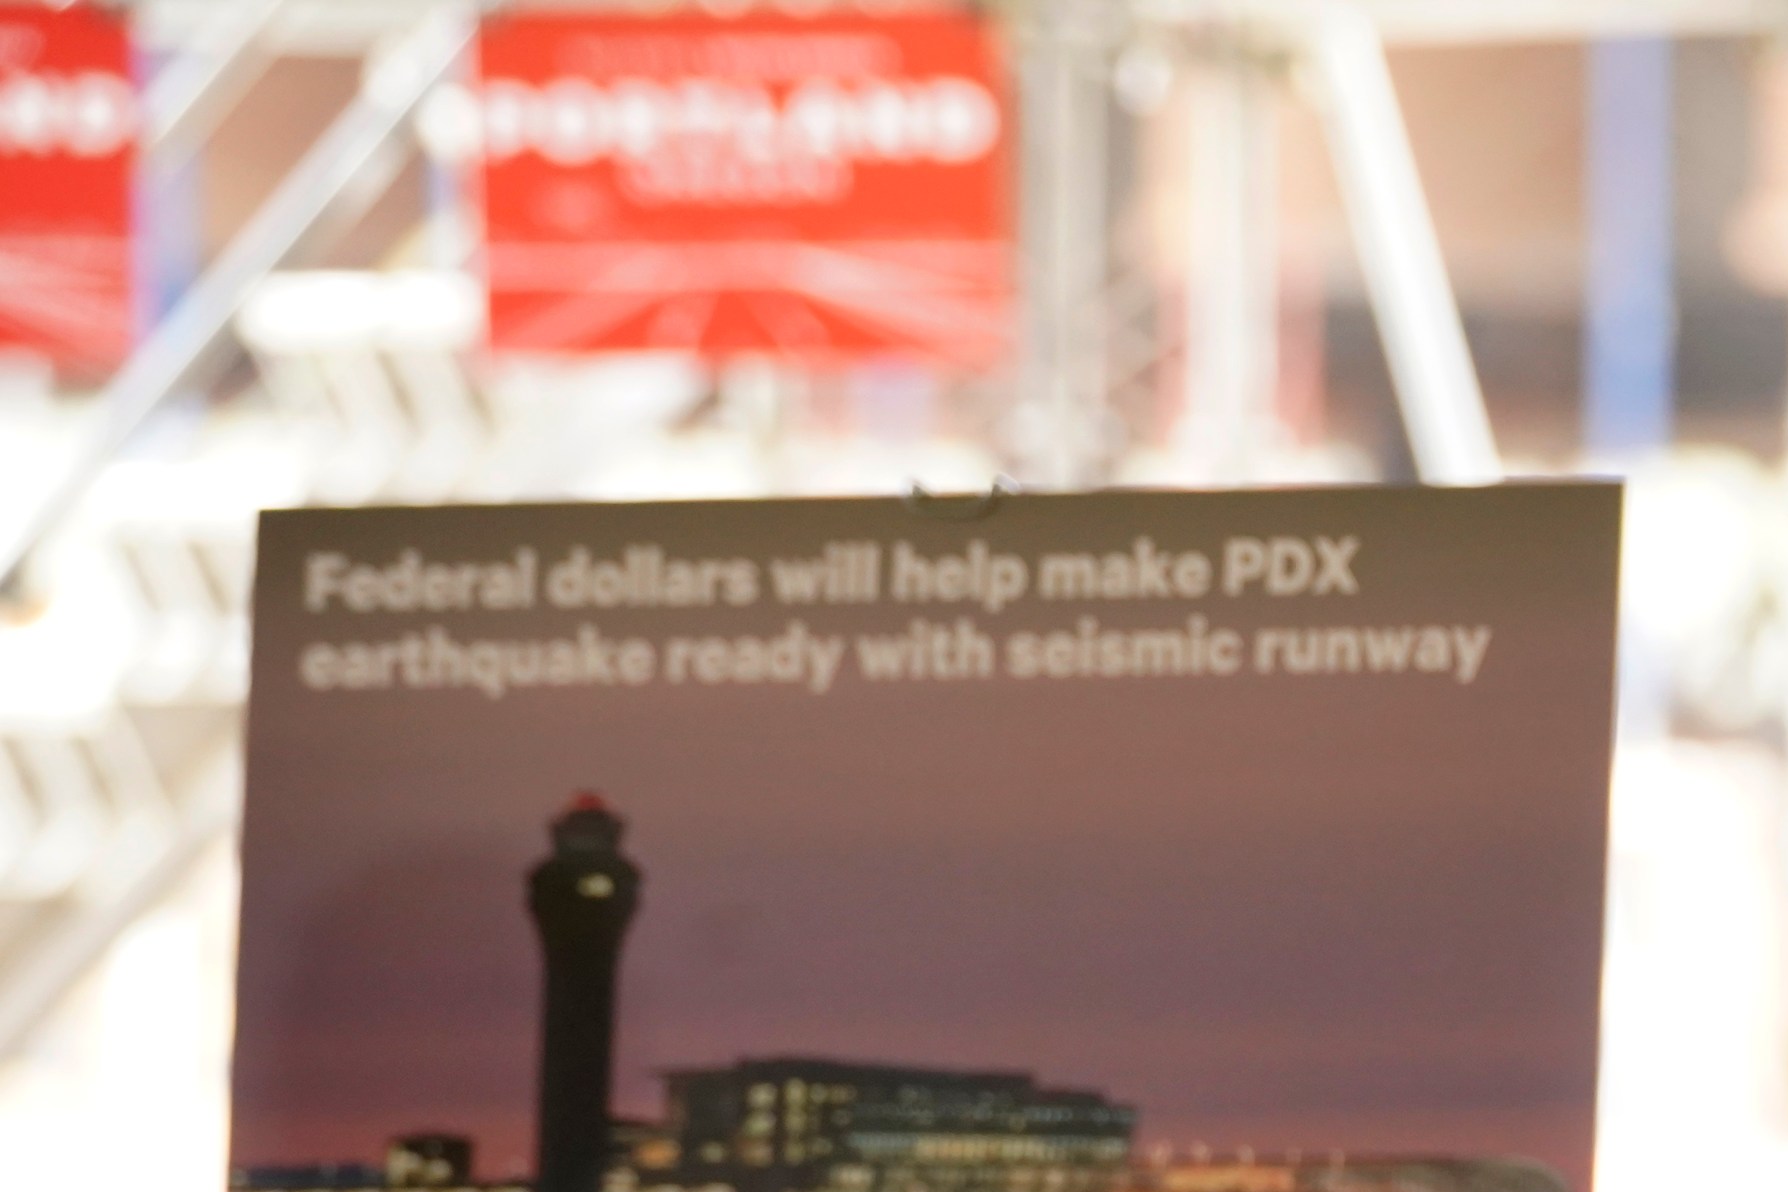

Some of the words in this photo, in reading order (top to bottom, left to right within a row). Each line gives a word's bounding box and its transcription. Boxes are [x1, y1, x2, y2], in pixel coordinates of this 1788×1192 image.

[304, 548, 538, 612] Federal
[544, 543, 760, 606] dollars
[768, 541, 882, 602] will
[889, 538, 1029, 611] help
[1037, 535, 1213, 598] make
[1222, 535, 1360, 595] PDX
[300, 624, 657, 700] earthquake
[664, 618, 845, 695] ready
[857, 616, 995, 683] with
[1004, 612, 1244, 681] seismic
[1254, 625, 1492, 684] runway
